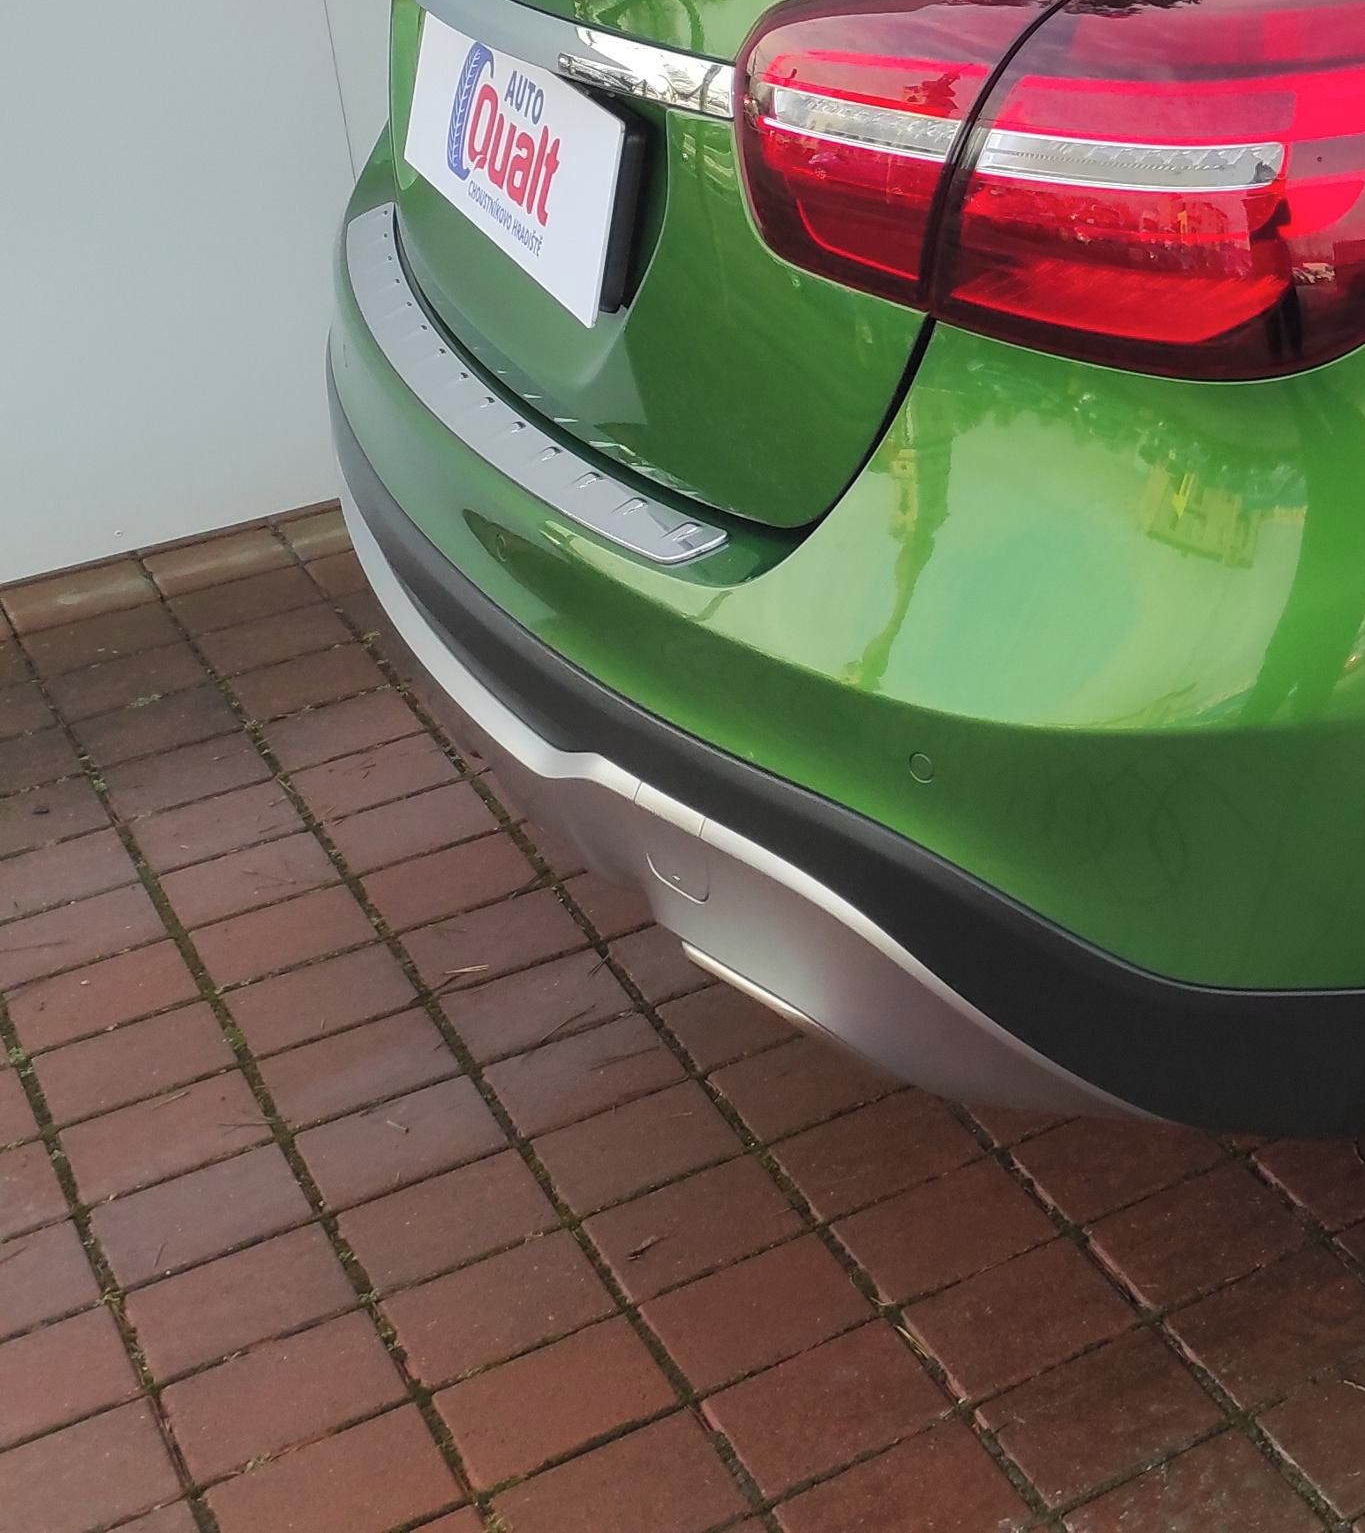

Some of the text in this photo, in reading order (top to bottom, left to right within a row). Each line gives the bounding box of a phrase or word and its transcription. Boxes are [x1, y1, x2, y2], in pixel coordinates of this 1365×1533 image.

[503, 70, 545, 125] AUTO
[467, 83, 561, 227] Qualt
[467, 179, 544, 258] CHOUSTNÍKOVO HRADIŠTĚ
